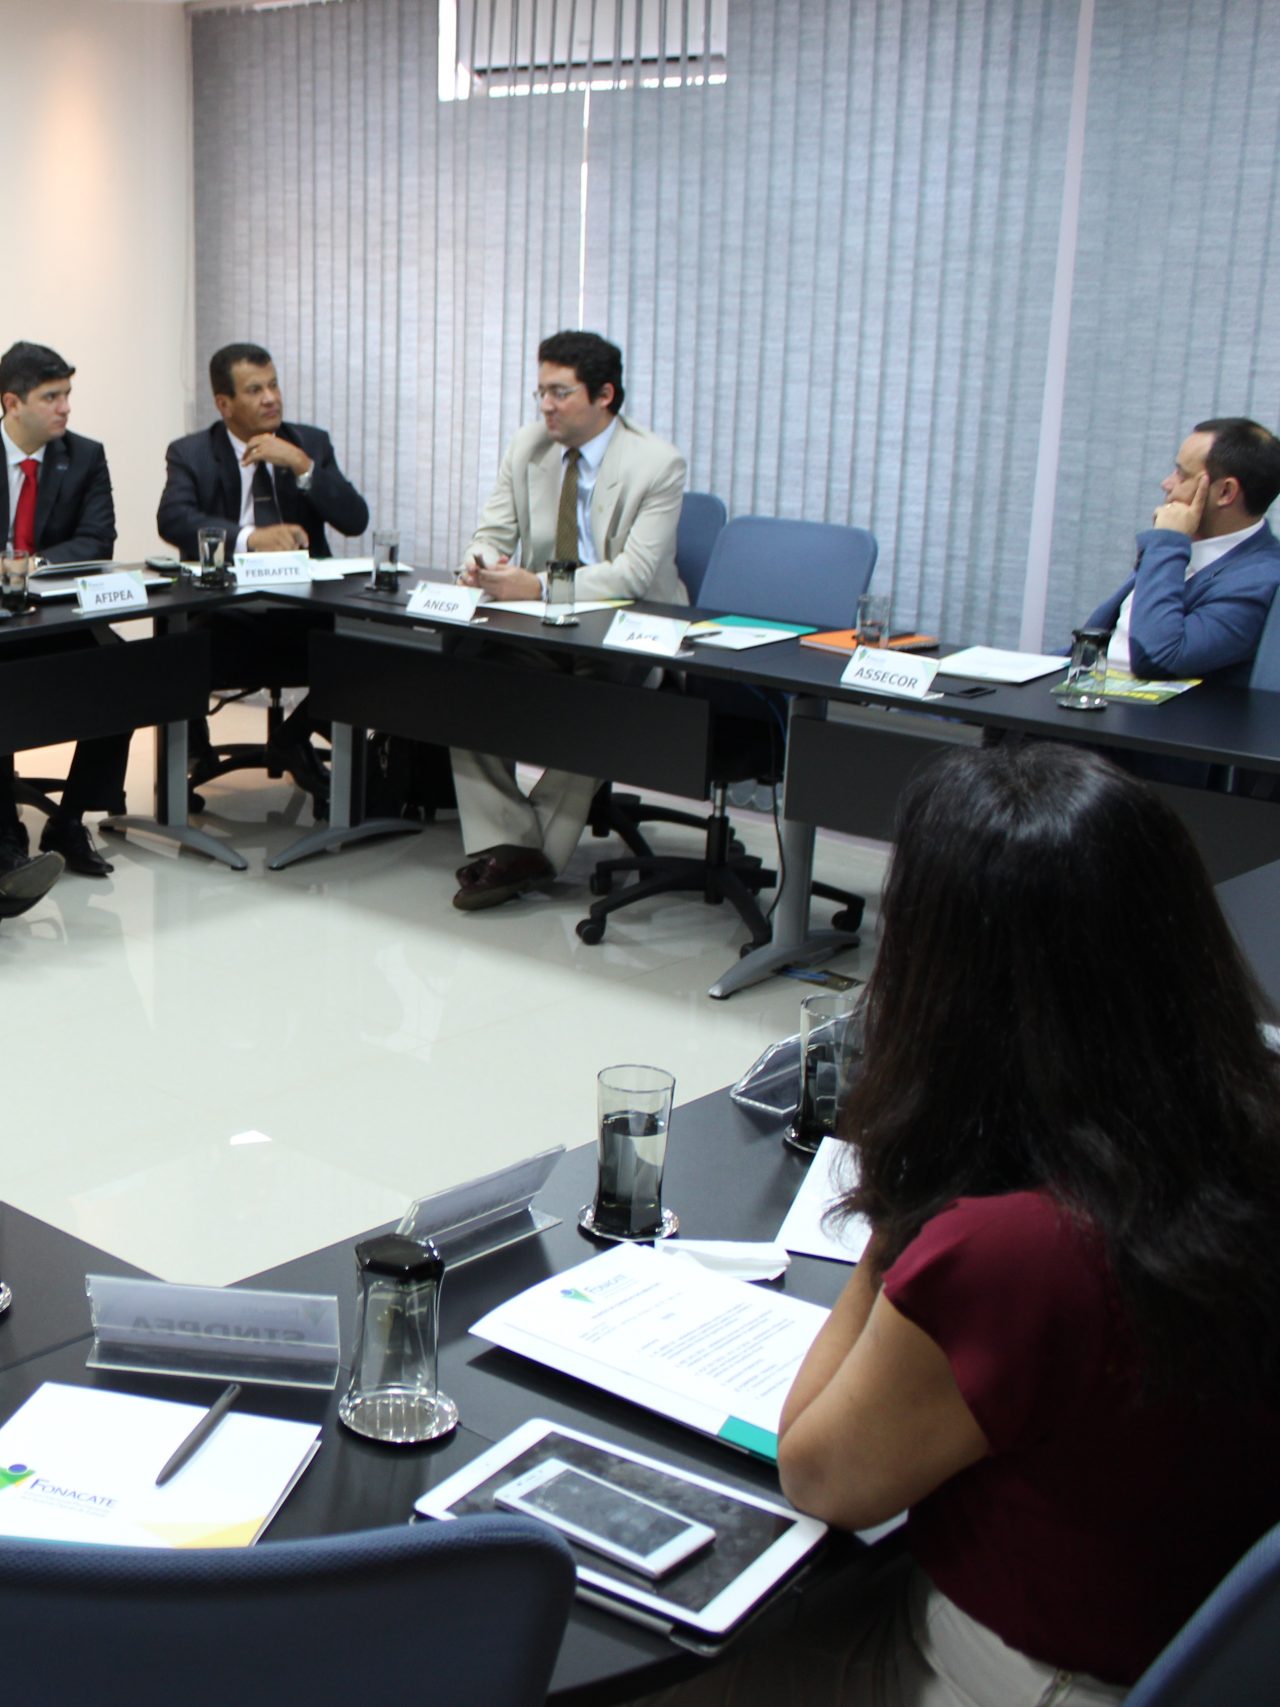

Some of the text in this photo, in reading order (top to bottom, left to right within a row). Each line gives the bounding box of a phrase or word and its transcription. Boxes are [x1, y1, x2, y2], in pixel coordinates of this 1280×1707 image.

[245, 567, 300, 578] FEBRAFITE
[95, 589, 134, 605] AFIPEA
[423, 599, 459, 613] ANESP
[854, 667, 919, 689] ASSECOR
[30, 1478, 118, 1508] FONACATE
